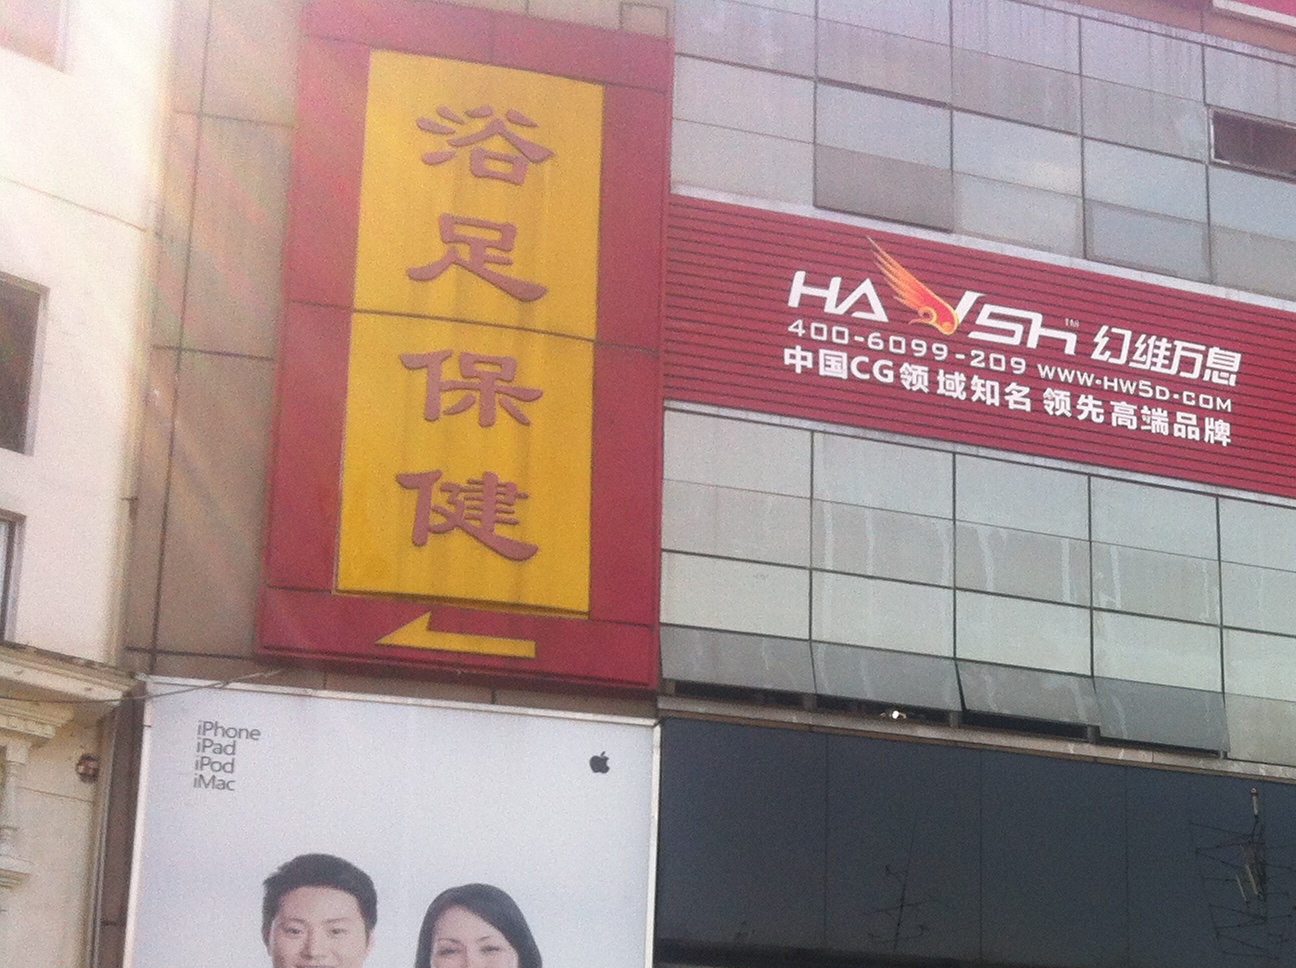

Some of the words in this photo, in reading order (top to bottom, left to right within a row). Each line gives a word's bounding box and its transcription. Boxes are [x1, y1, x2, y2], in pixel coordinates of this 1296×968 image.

[396, 104, 553, 562] 浴足保健
[787, 319, 1027, 376] 400-6099-209
[1090, 325, 1242, 387] 幻维万息
[1042, 387, 1232, 447] 领先高端品牌
[196, 737, 236, 756] iPad
[197, 720, 261, 741] iPhone
[193, 773, 236, 791] iMac
[195, 755, 235, 774] iPod
